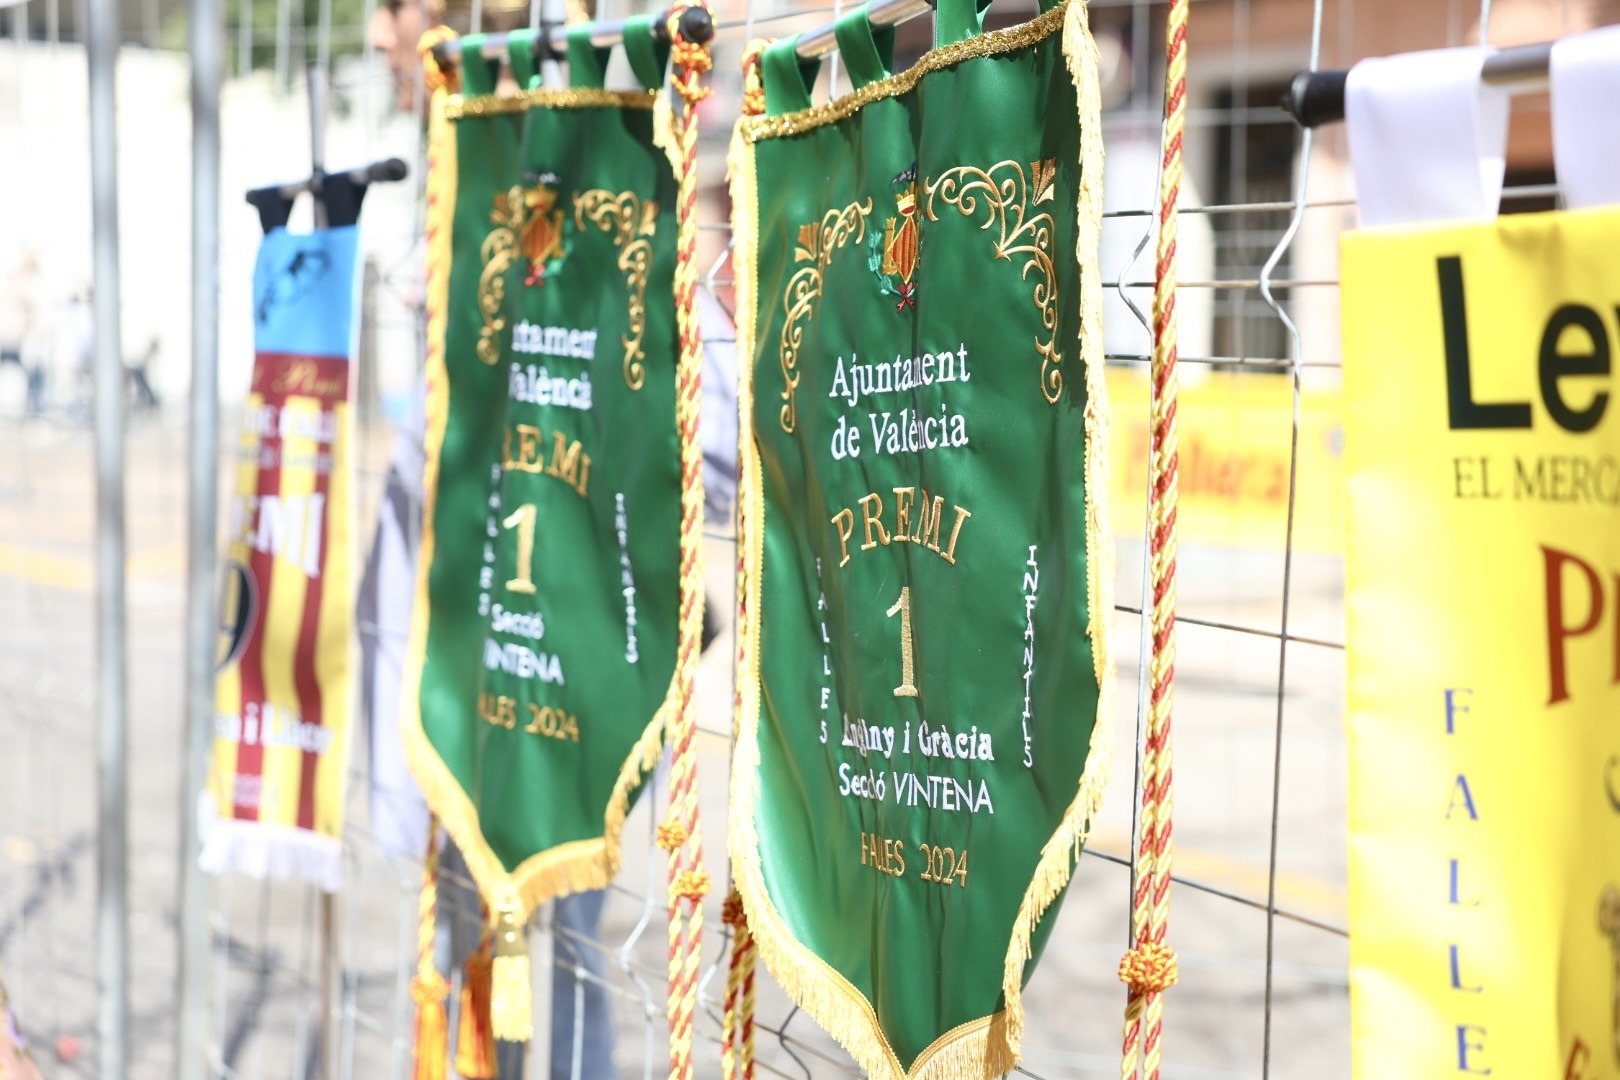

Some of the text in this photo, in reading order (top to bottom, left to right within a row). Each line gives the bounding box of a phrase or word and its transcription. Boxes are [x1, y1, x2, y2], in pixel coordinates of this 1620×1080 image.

[1436, 254, 1620, 435] Le
[831, 404, 969, 460] de València
[1453, 454, 1620, 507] EL MERC
[502, 503, 538, 594] 1
[831, 486, 972, 568] PREMI
[886, 586, 919, 697] 1
[1022, 544, 1039, 768] INFANTILS
[902, 720, 911, 754] i
[918, 719, 995, 761] Gràcia
[893, 771, 994, 815] VINTENA
[919, 843, 968, 887] 2024
